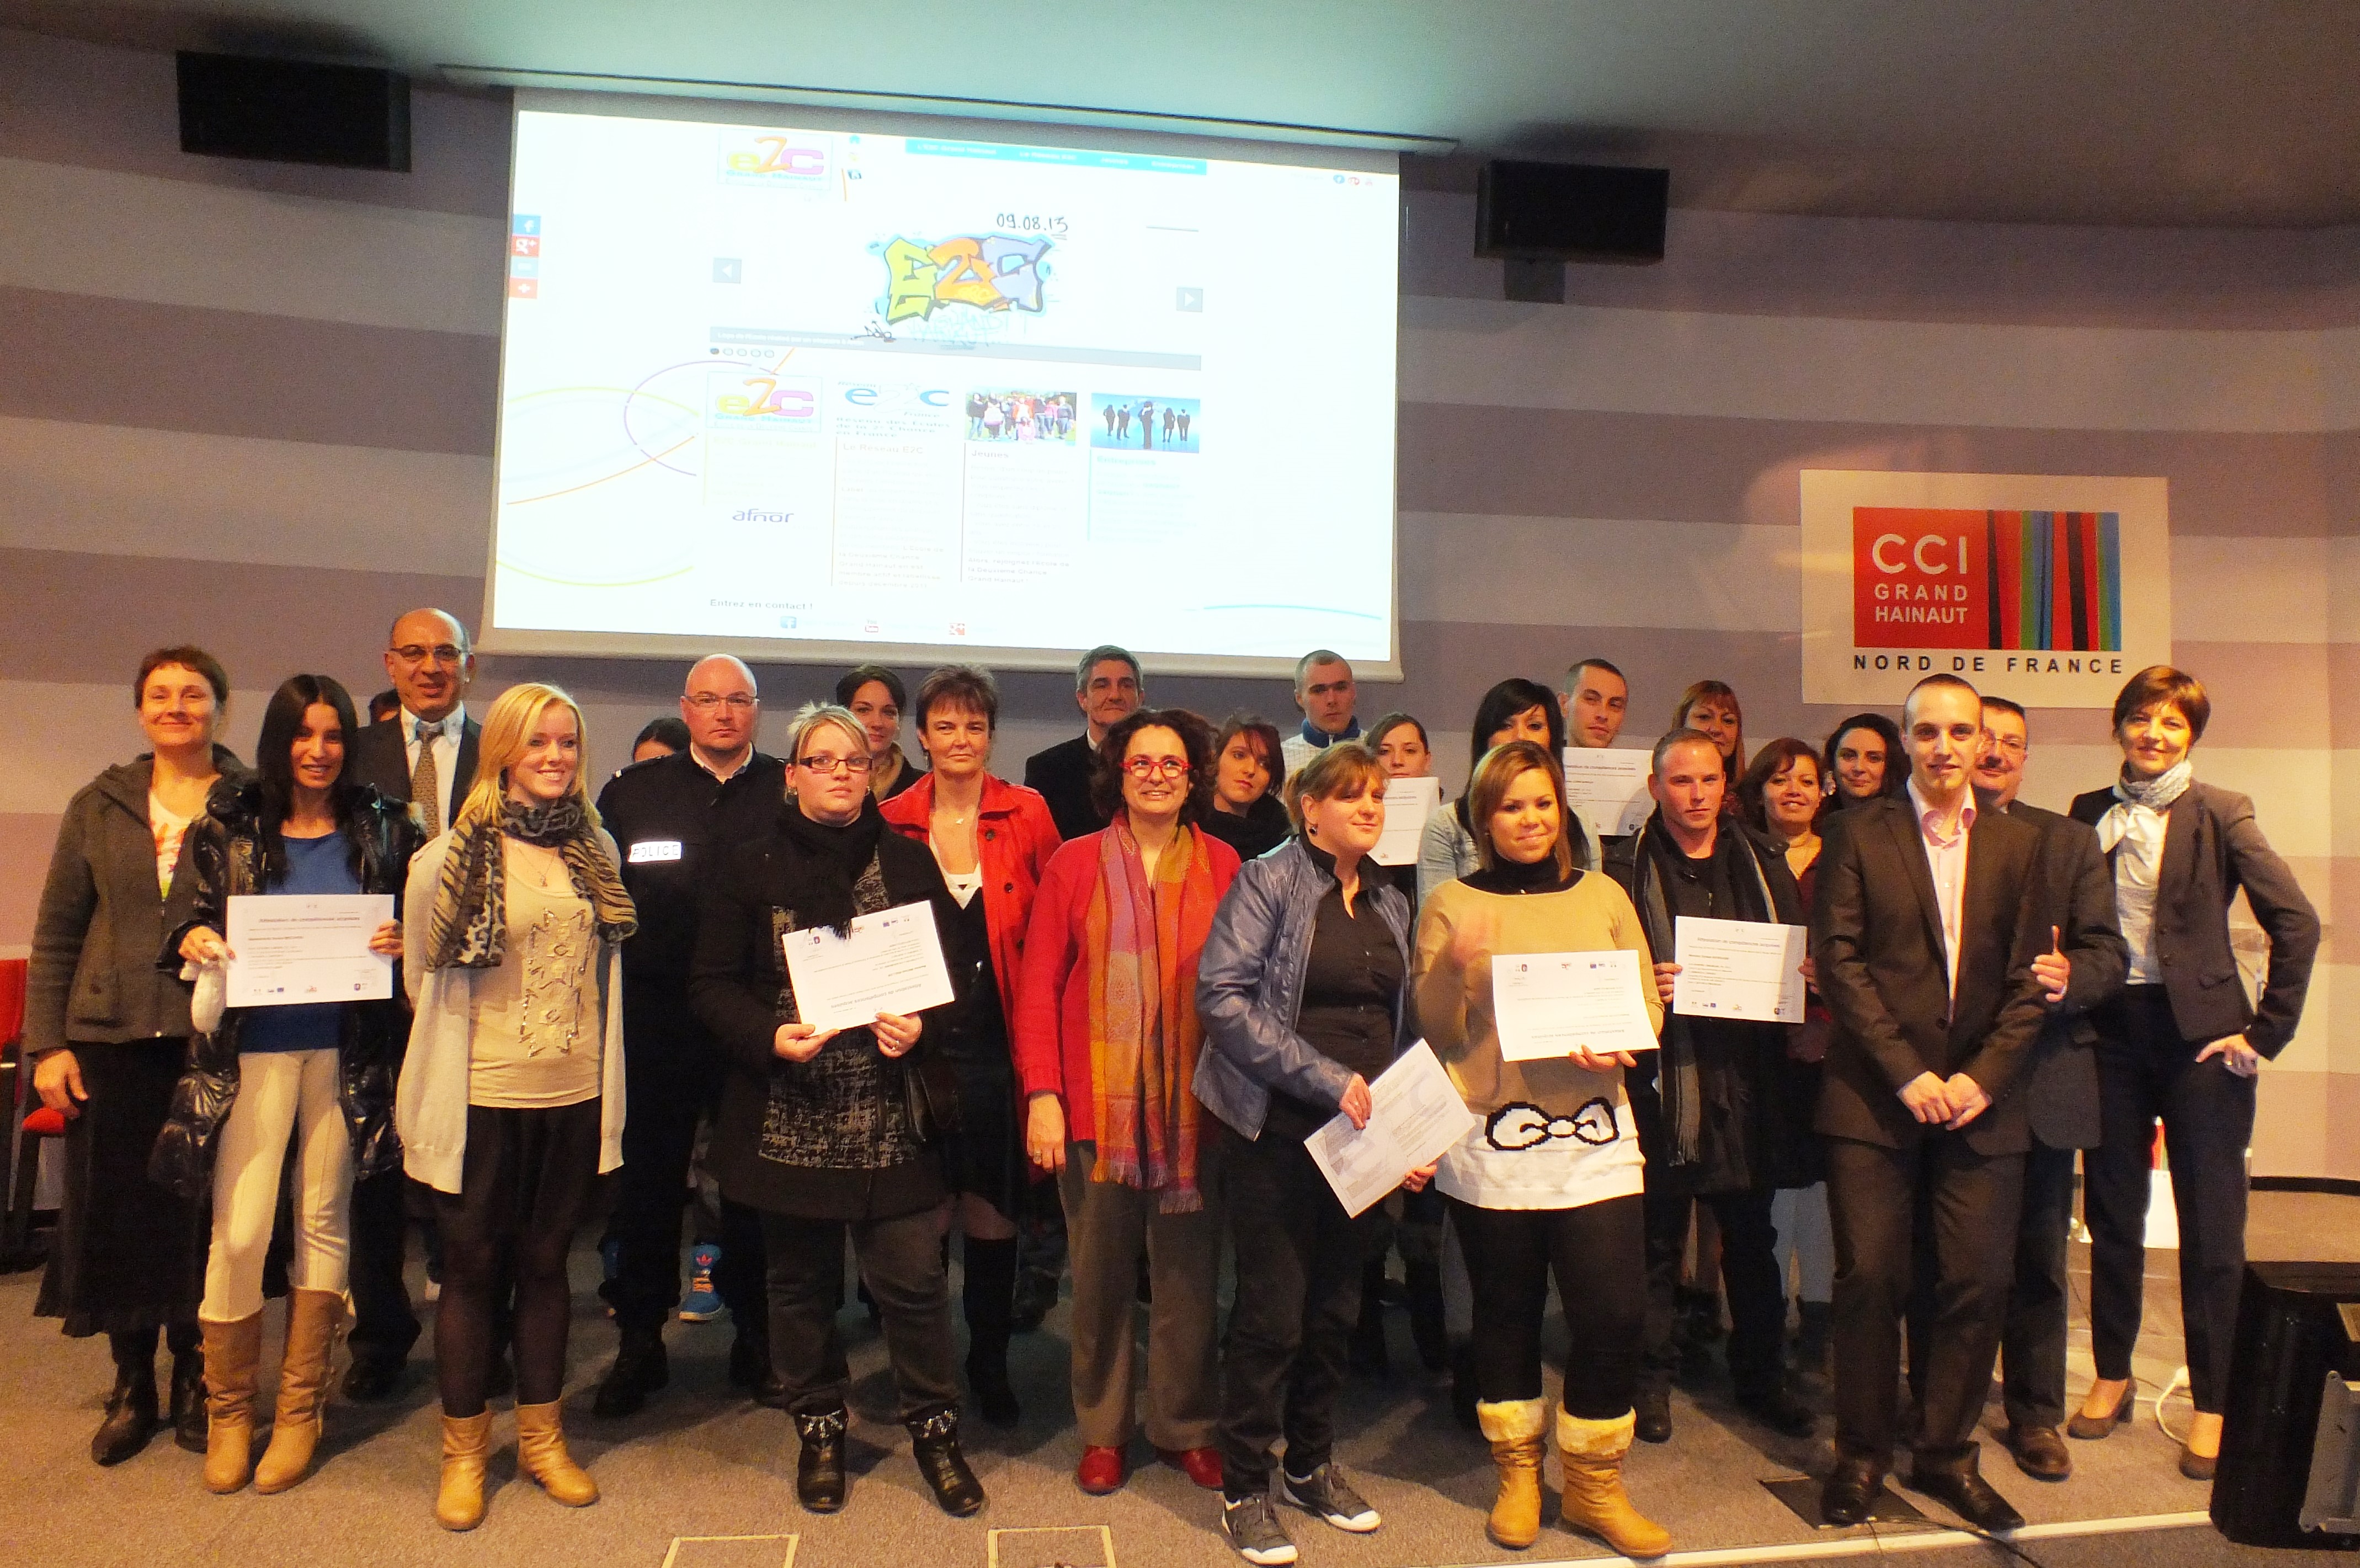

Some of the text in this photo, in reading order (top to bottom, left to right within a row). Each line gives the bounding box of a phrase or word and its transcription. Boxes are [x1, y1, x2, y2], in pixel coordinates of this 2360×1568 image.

[732, 508, 795, 523] afnor
[1871, 533, 1968, 575] CCI
[1874, 583, 1968, 602] GRAND
[710, 599, 744, 608] Entrez
[765, 601, 807, 610] contact
[1875, 605, 1968, 625] HAINAUT
[1854, 654, 2123, 674] NORD DE FRANCE
[632, 844, 680, 857] POLICE
